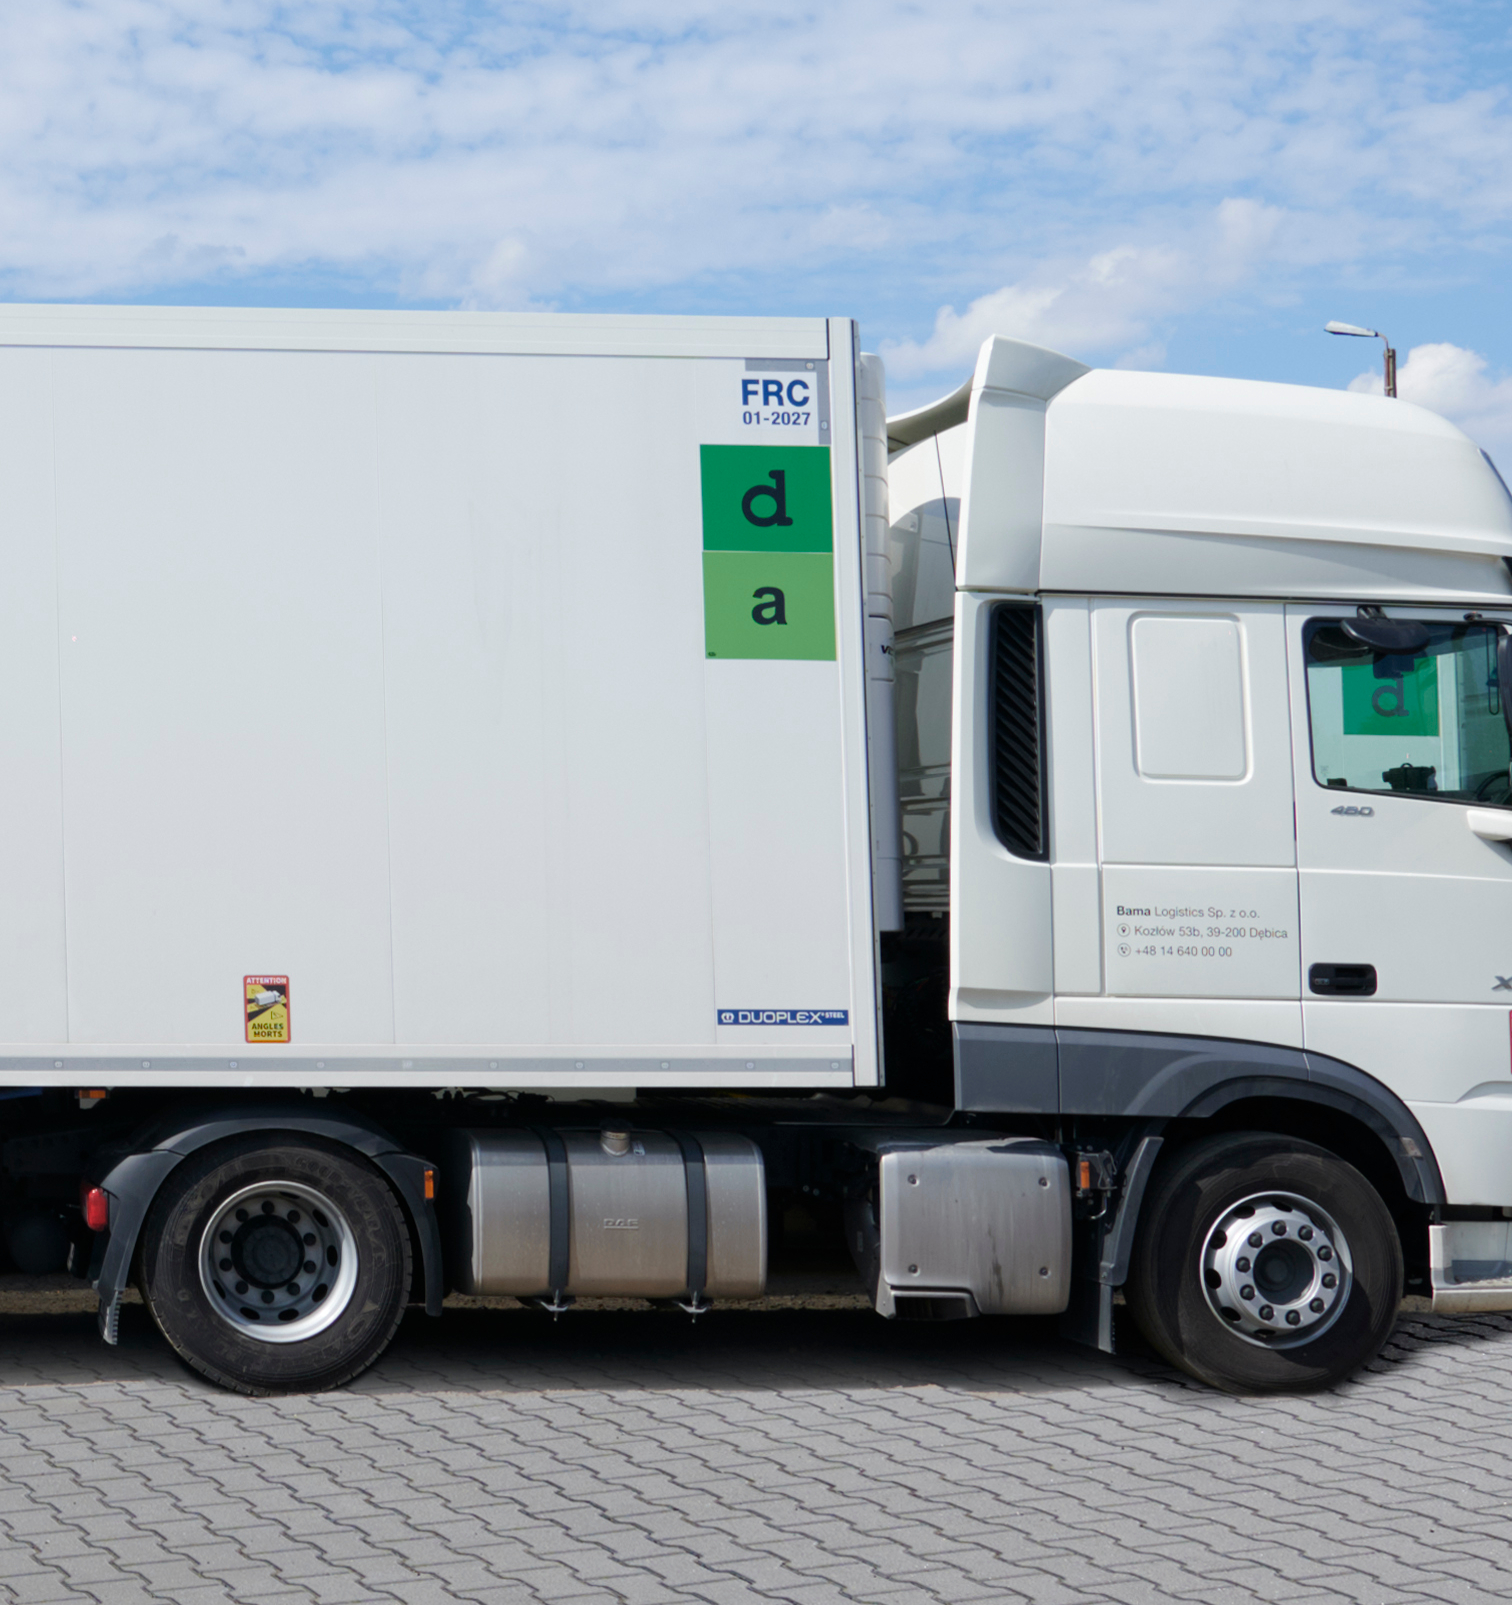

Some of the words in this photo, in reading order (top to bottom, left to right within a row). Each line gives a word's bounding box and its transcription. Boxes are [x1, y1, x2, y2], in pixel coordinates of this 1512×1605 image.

[741, 379, 810, 407] FRC
[742, 412, 811, 426] 01-2027
[741, 470, 794, 528] d
[750, 586, 788, 626] a
[1116, 905, 1151, 917] Bama
[1154, 906, 1205, 920] Logistics
[1208, 906, 1226, 920] Sp.
[1229, 909, 1237, 918] z
[1239, 909, 1261, 919] o.o.
[1134, 925, 1176, 937] Kozłów
[1178, 926, 1204, 938] 53b,
[1207, 926, 1246, 938] 39-200
[1249, 927, 1289, 940] Dębica
[1135, 945, 1157, 956] +48
[1161, 945, 1174, 956] 14
[1177, 945, 1198, 957] 640
[1201, 945, 1215, 957] 00
[1218, 946, 1233, 957] 00
[738, 1011, 823, 1024] DUOPLEX
[252, 1022, 284, 1030] ANGLES
[253, 1030, 283, 1038] MORTS
